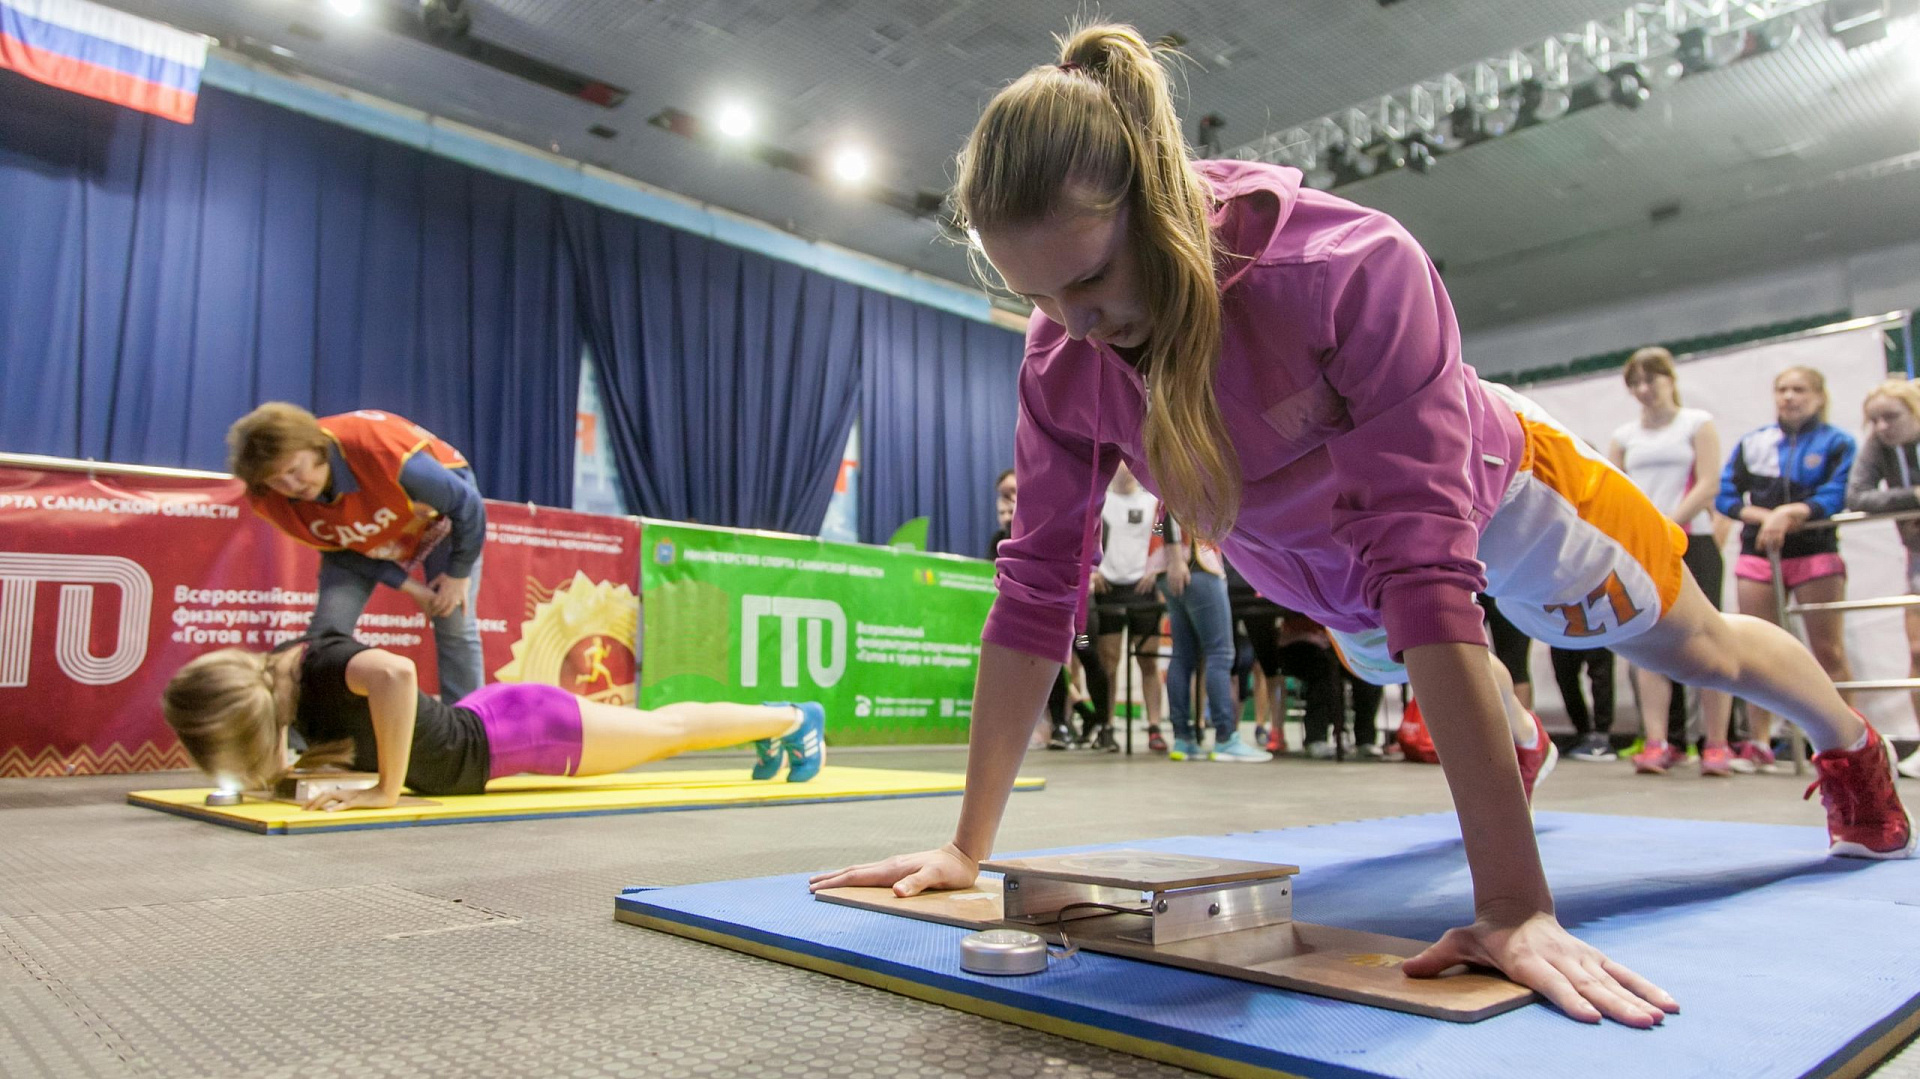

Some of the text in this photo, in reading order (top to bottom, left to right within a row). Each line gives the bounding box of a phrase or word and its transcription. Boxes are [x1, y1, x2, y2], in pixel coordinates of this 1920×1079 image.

[41, 495, 158, 515] САМАРСКОЙ
[161, 502, 240, 518] ОБЛАСТИ
[309, 507, 398, 547] Сдья
[174, 585, 319, 607] Всероссийски
[356, 612, 426, 629] тивный
[171, 626, 242, 644] «Готов
[246, 630, 258, 643] к
[353, 628, 422, 647] бороне»
[741, 594, 847, 688] ГТО
